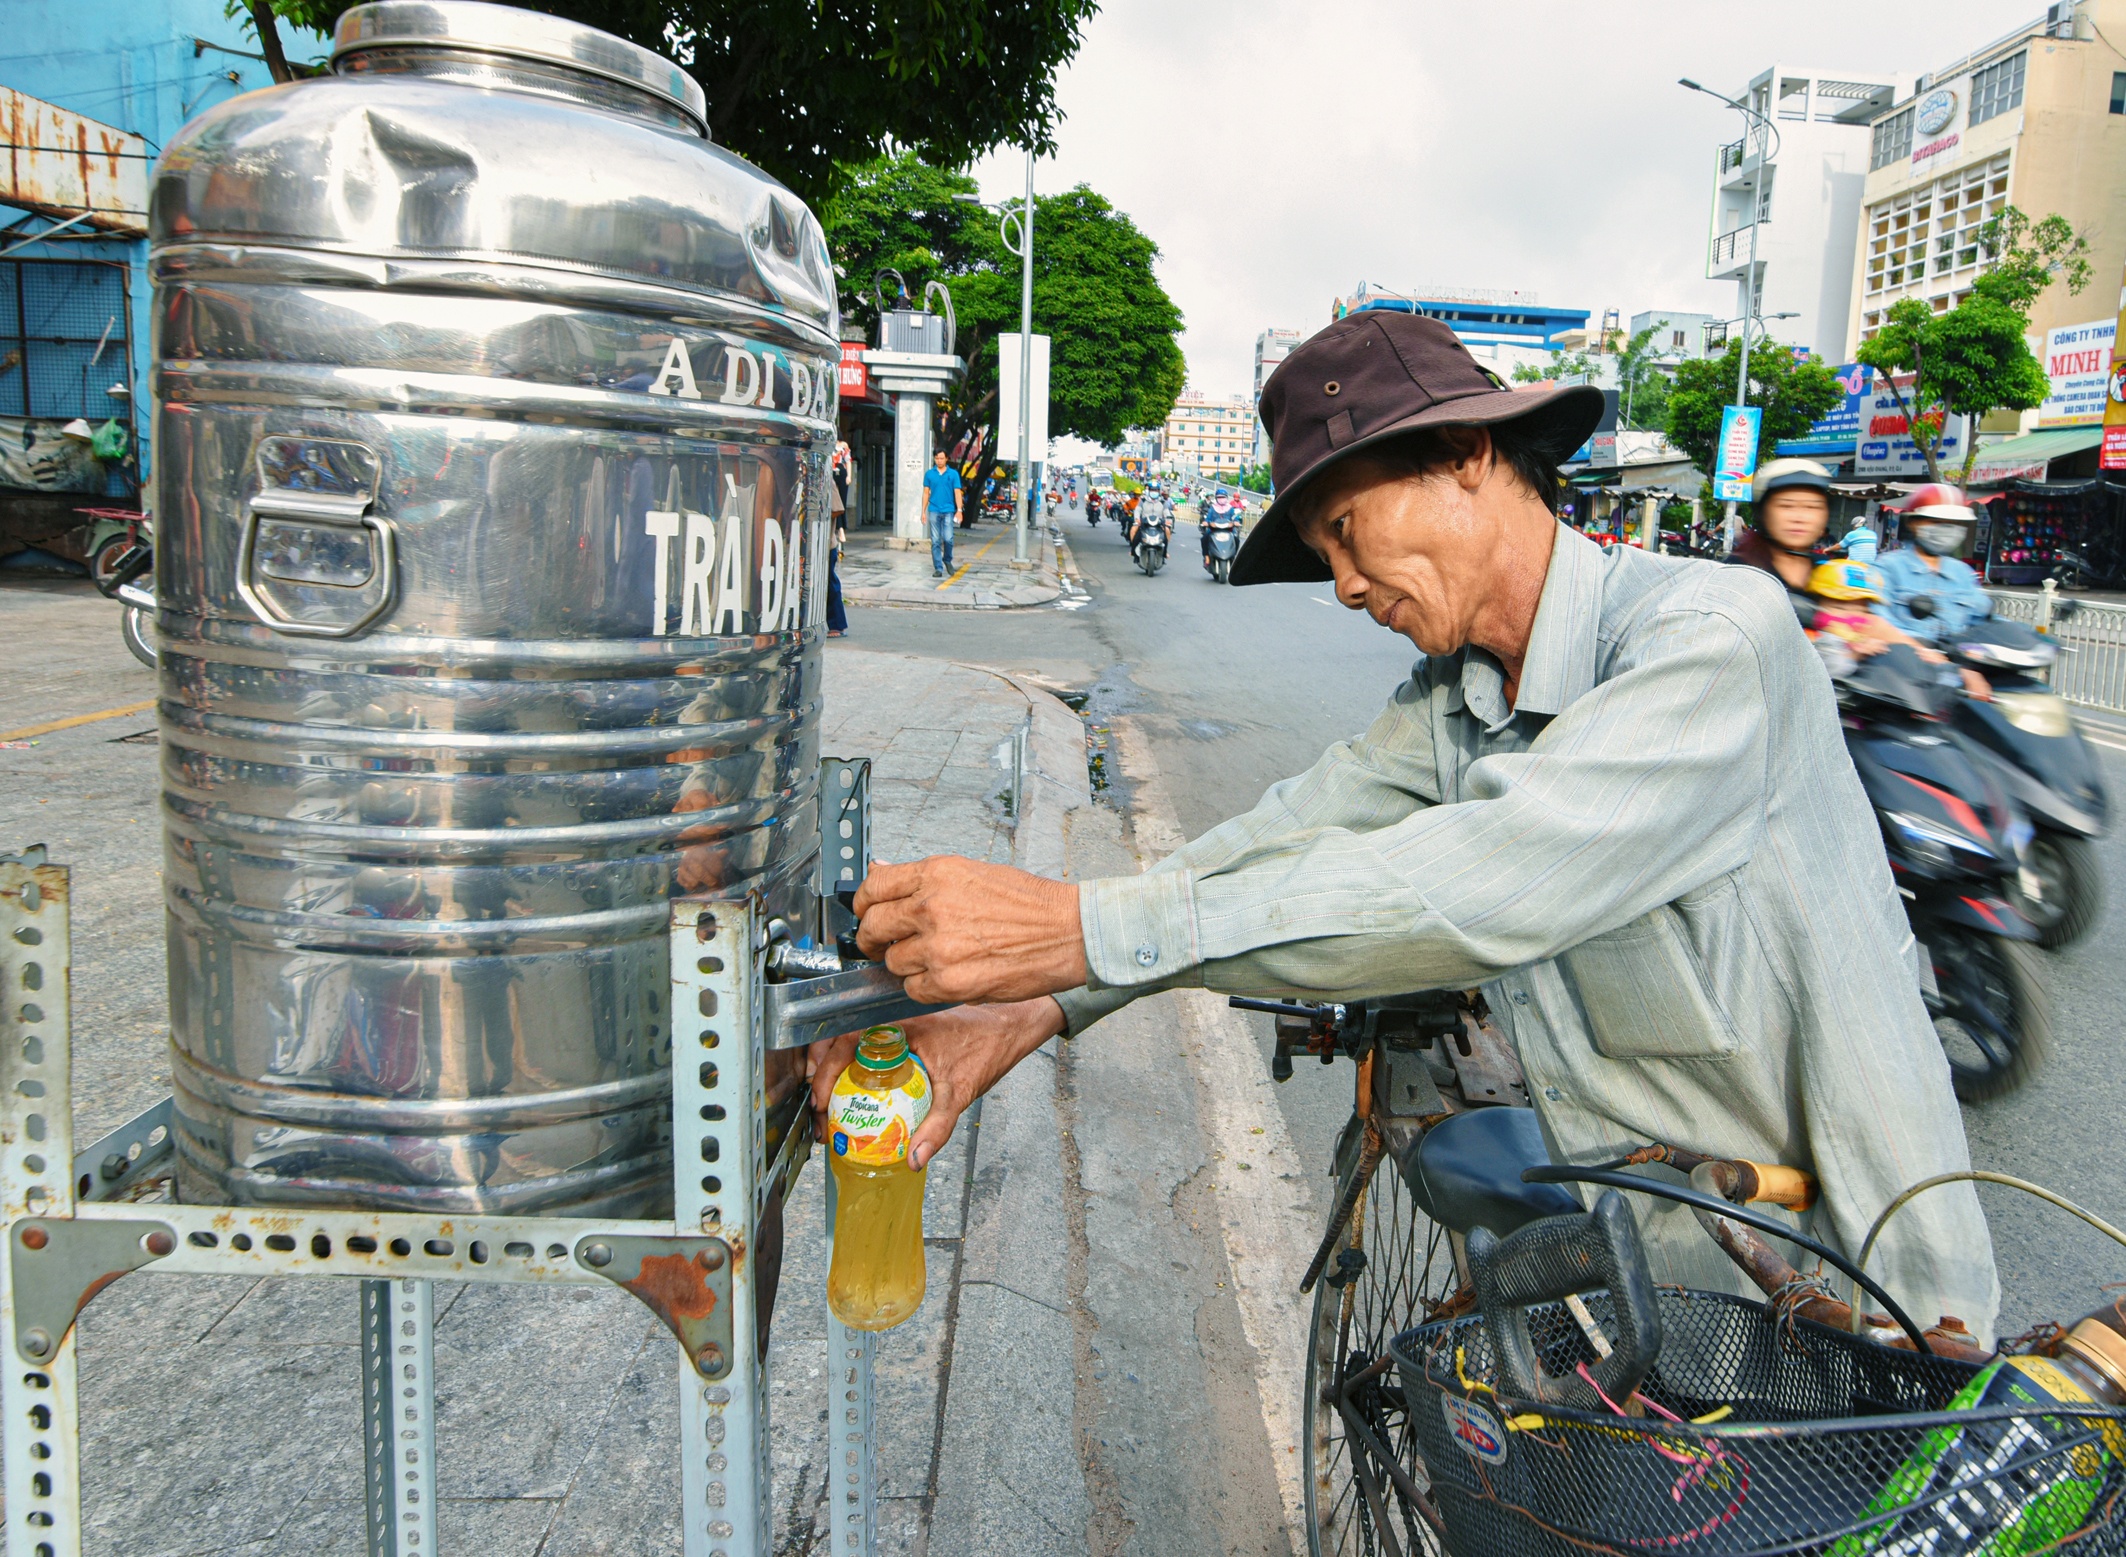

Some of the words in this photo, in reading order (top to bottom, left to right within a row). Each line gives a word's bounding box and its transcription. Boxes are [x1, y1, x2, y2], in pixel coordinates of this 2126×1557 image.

[2054, 331, 2077, 346] CÔNG
[2079, 329, 2090, 341] TY
[2092, 325, 2115, 339] TNHH
[648, 338, 702, 399] A
[720, 346, 777, 409] DI
[2049, 349, 2102, 377] MINH
[2067, 391, 2086, 401] CAMERA
[2087, 390, 2101, 400] QUAN
[645, 473, 743, 636] TRÀ
[760, 483, 803, 633] ĐÁ
[850, 1096, 879, 1112] Tropicana
[840, 1107, 886, 1130] Twister
